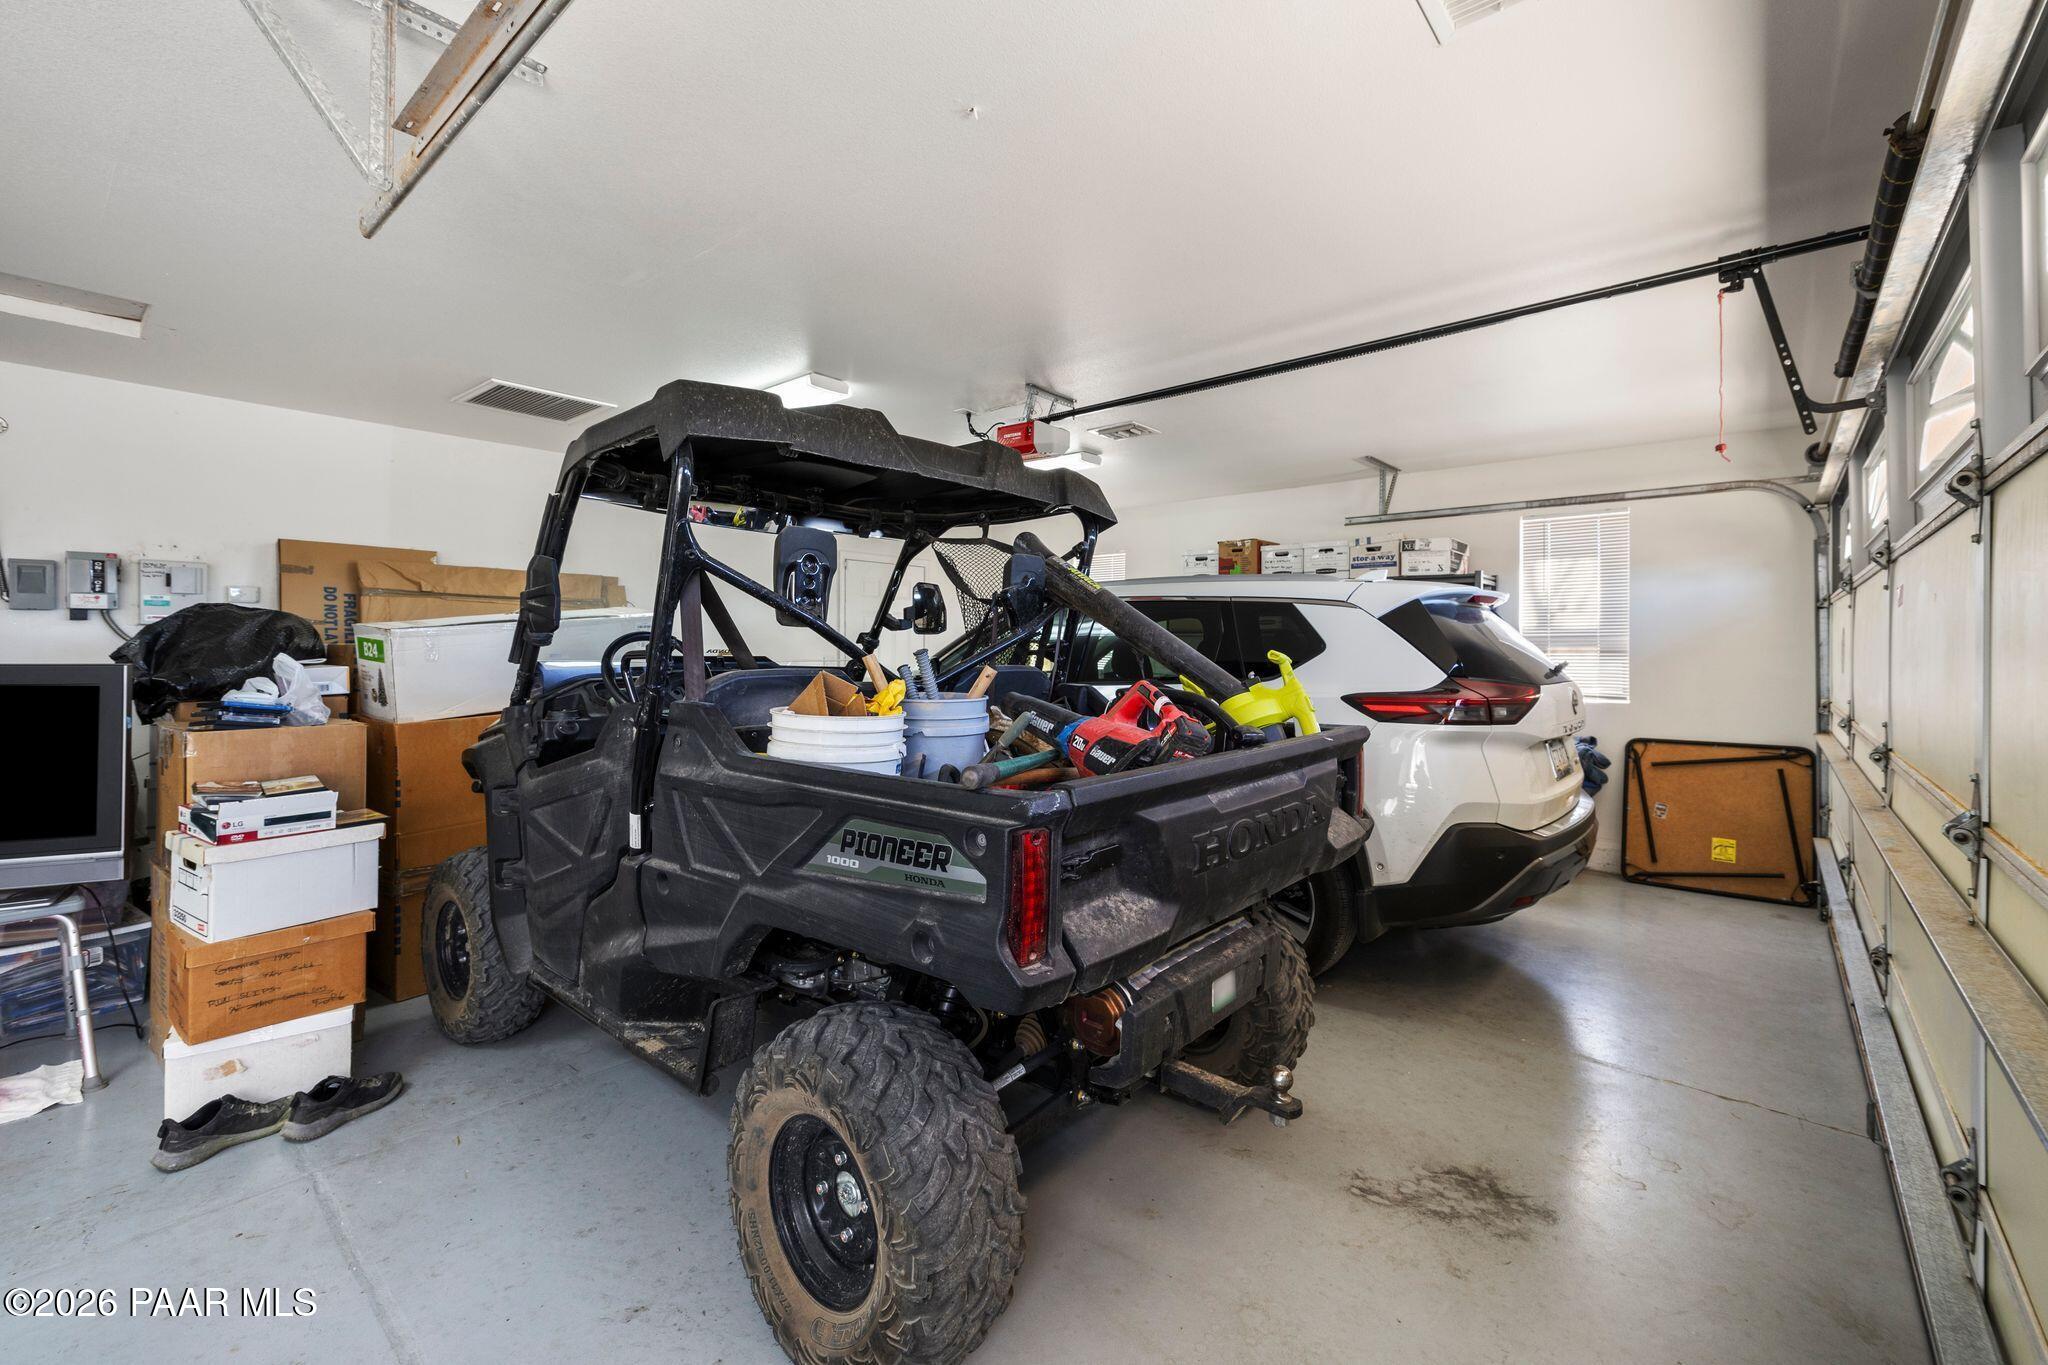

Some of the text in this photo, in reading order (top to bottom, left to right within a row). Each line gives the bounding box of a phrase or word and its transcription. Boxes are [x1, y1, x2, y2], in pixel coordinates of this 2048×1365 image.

[344, 593, 358, 644] FRAGIL
[363, 641, 378, 657] B24
[232, 820, 244, 828] LG
[1191, 794, 1326, 878] HONDA
[840, 828, 953, 873] PIONEER
[826, 854, 860, 869] 1000
[904, 873, 946, 888] HONDA
